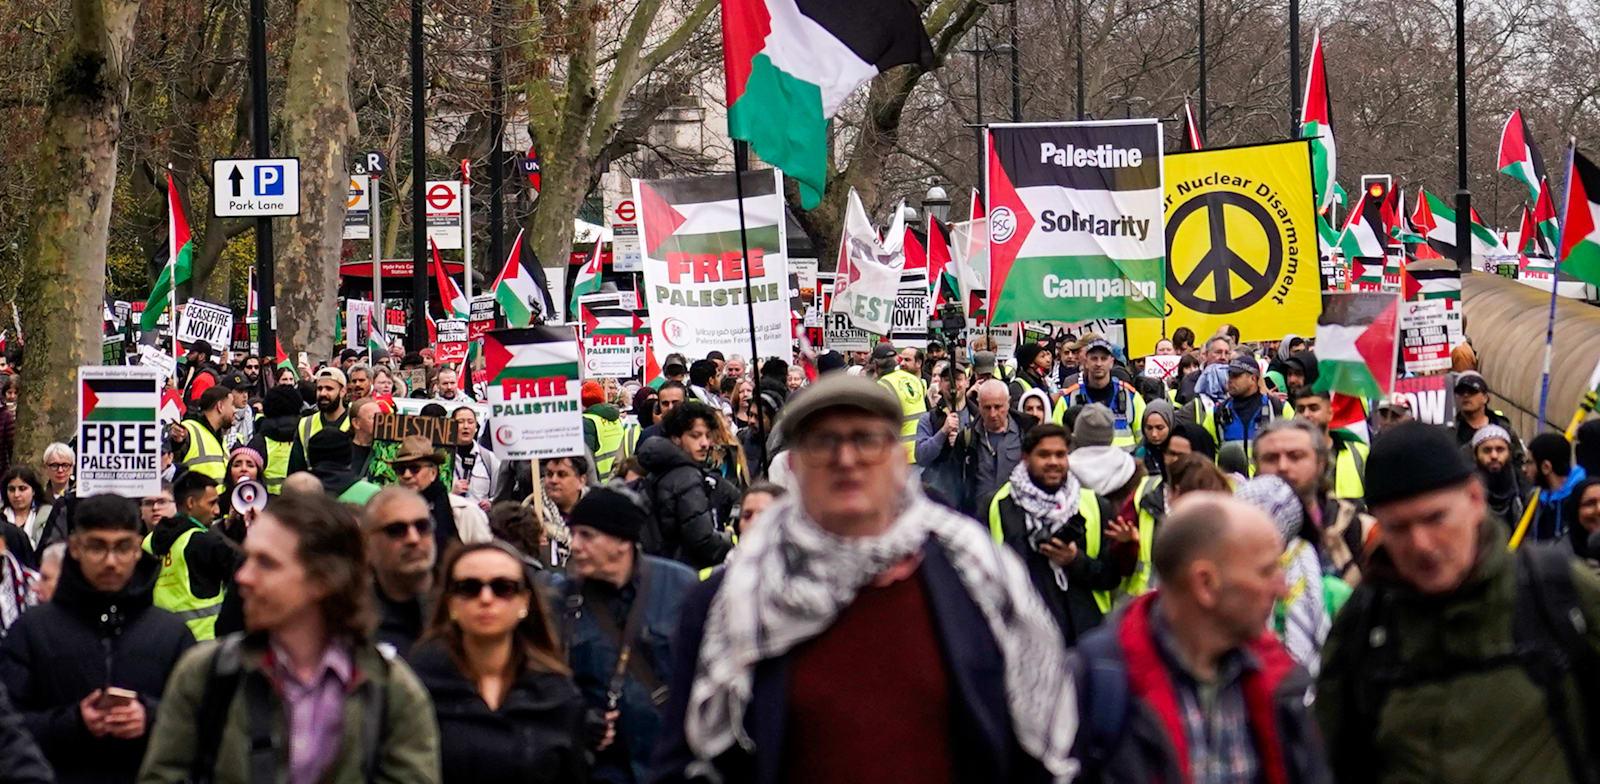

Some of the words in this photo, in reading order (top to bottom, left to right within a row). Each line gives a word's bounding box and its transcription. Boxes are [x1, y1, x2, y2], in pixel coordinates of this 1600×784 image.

[367, 153, 382, 171] R
[1040, 142, 1142, 168] Palestine
[525, 161, 540, 171] UN
[259, 167, 278, 194] P
[229, 200, 254, 210] Park
[258, 201, 284, 210] Lane
[992, 218, 1010, 231] PSC
[1041, 209, 1149, 242] Solidarity
[1176, 171, 1252, 196] Nuclear
[1255, 183, 1299, 305] Disarmament
[666, 248, 766, 284] FREE
[1524, 270, 1549, 280] FREE
[655, 282, 780, 307] PALESTINE
[1042, 273, 1157, 302] Campaign
[132, 302, 147, 312] STO
[471, 300, 495, 311] FREEDOM
[855, 294, 894, 324] EST
[894, 297, 925, 309] SEFIRE
[186, 305, 230, 327] CEASEFIRE
[386, 310, 406, 325] FREE
[470, 311, 495, 322] PALESTINE
[824, 314, 855, 330] FR
[893, 309, 921, 327] OW!
[186, 319, 222, 343] NOW!
[438, 322, 466, 331] FREEDOM
[824, 330, 868, 338] PALESTINE
[969, 328, 1012, 336] PALSTINE
[437, 333, 467, 342] PALESTINE
[593, 334, 626, 346] FREE
[695, 337, 732, 345] Palestinian
[733, 336, 751, 344] Foru
[763, 333, 782, 341] Britain
[587, 347, 631, 355] PALESTINE
[501, 375, 568, 400] FREE
[492, 400, 578, 417] PALESTINE
[1403, 389, 1446, 425] OW
[374, 413, 455, 445] PALESTINE
[82, 424, 157, 454] FREE
[81, 455, 157, 470] PALESTINE
[116, 471, 157, 480] OCCUPATION
